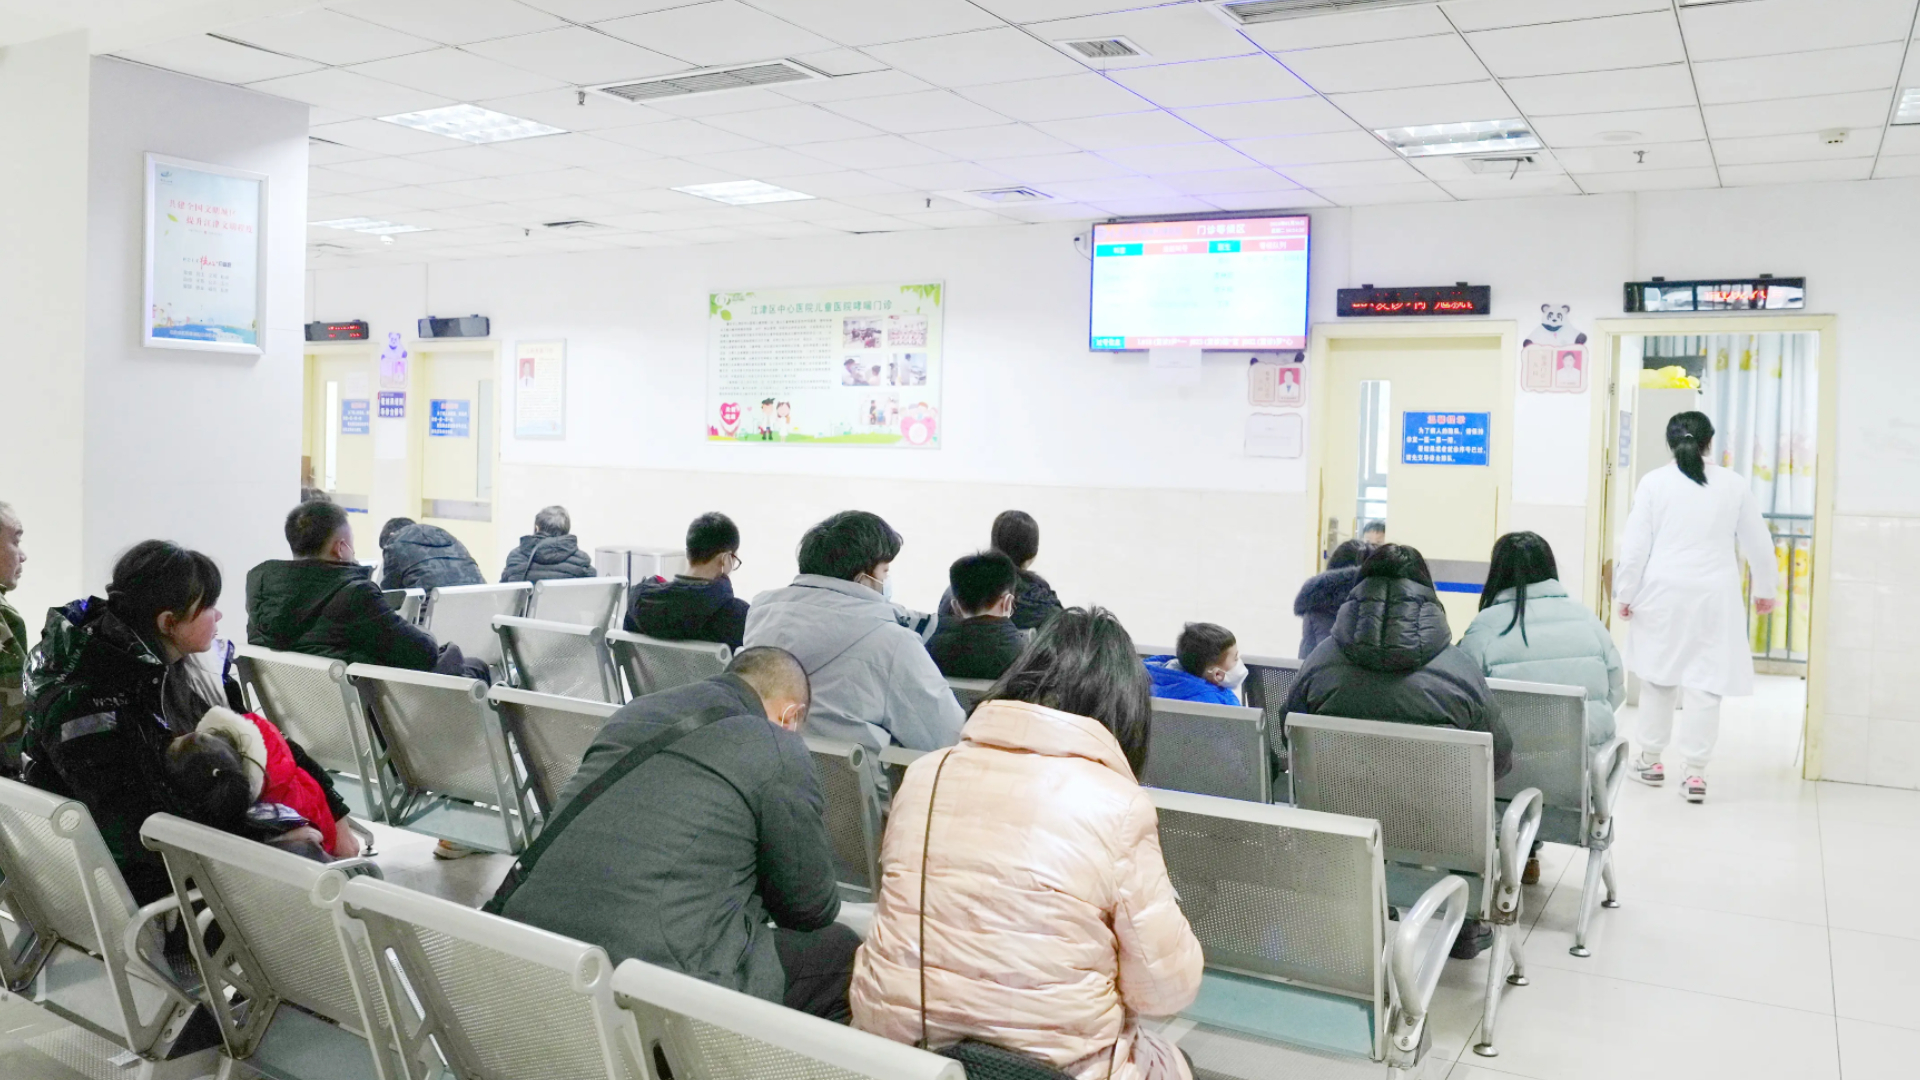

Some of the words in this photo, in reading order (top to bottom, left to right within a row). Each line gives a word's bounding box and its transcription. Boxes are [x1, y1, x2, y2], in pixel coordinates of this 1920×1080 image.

[751, 300, 893, 315] 江津区中心医院儿童医院哮喘门诊
